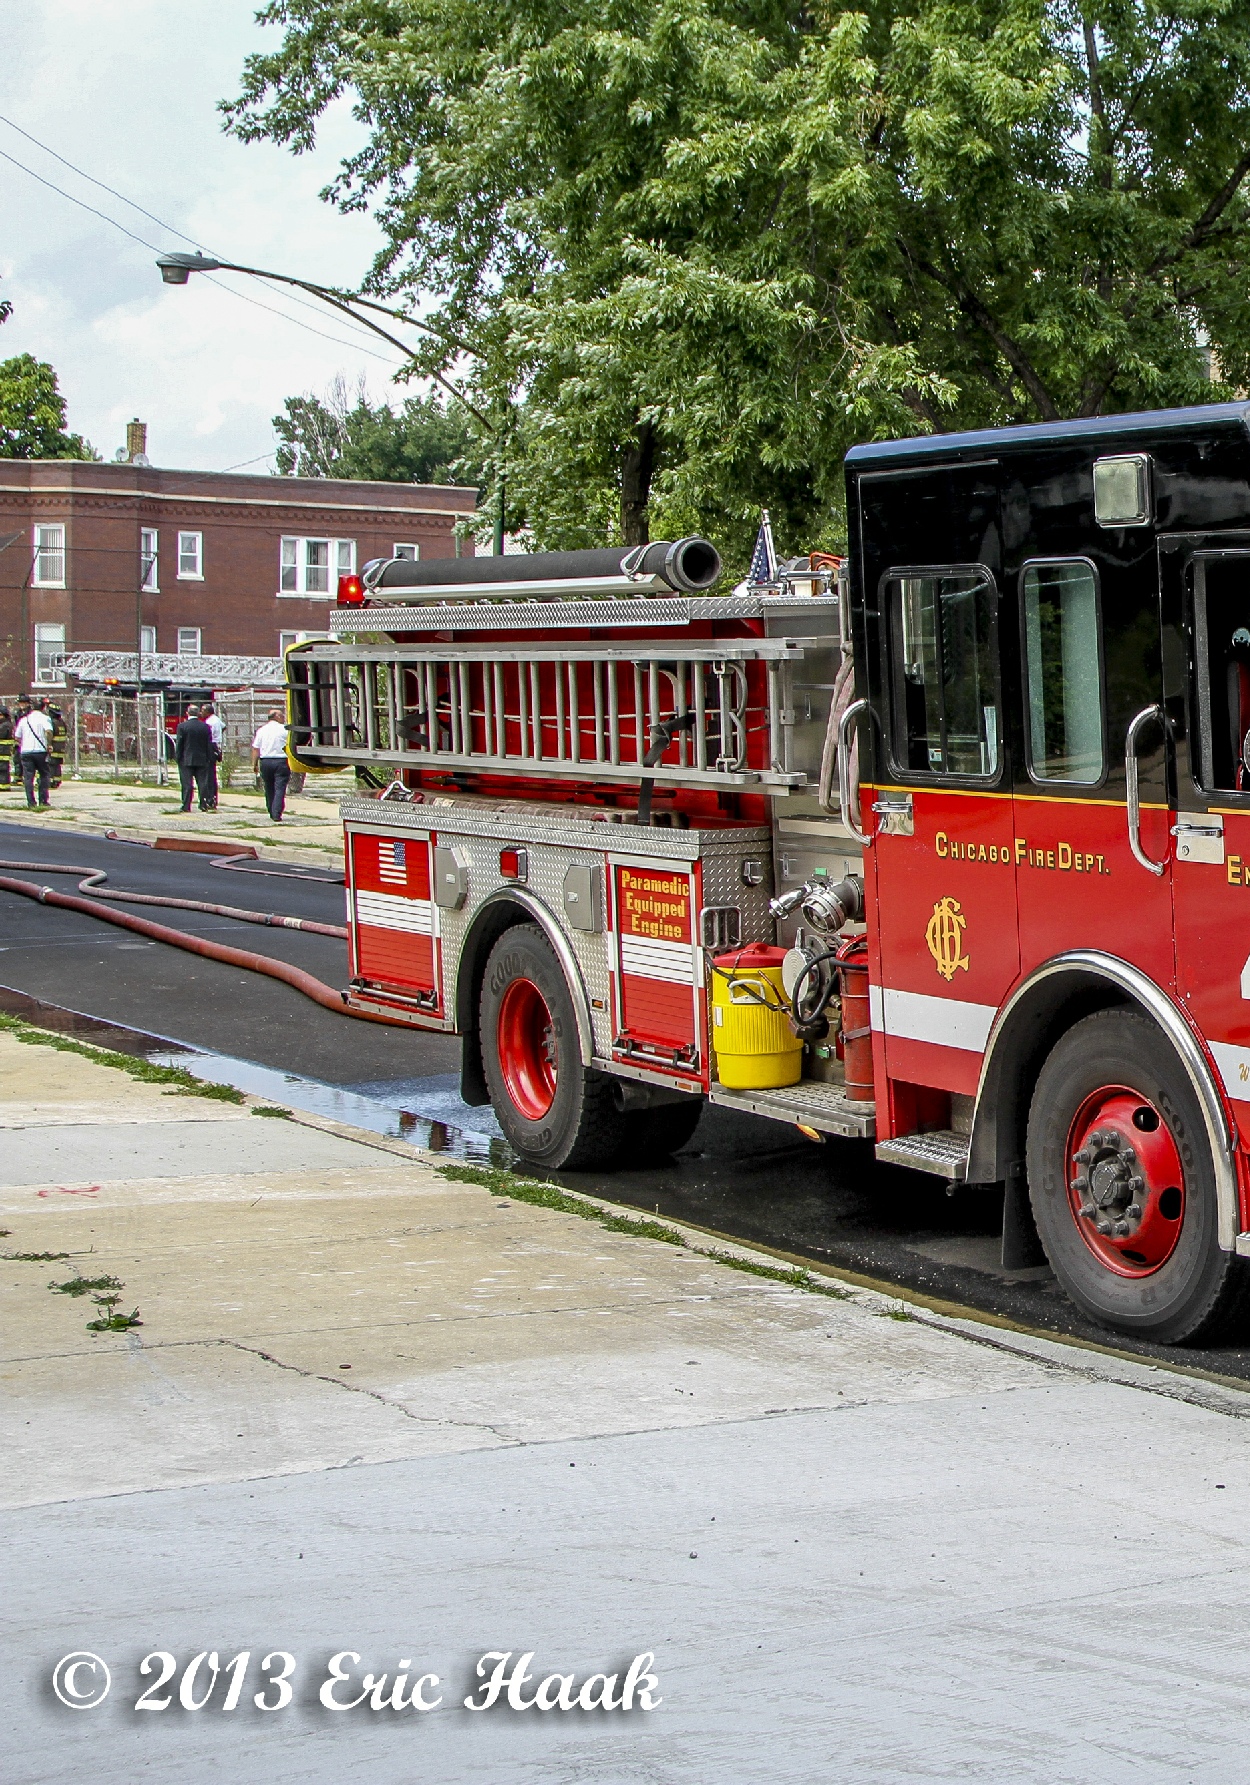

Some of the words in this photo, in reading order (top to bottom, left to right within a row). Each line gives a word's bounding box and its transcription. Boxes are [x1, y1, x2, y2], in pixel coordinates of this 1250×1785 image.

[935, 831, 1011, 864] CHICAGO
[621, 870, 690, 897] Paramedic
[625, 891, 686, 918] Equipped
[631, 913, 682, 938] Engine
